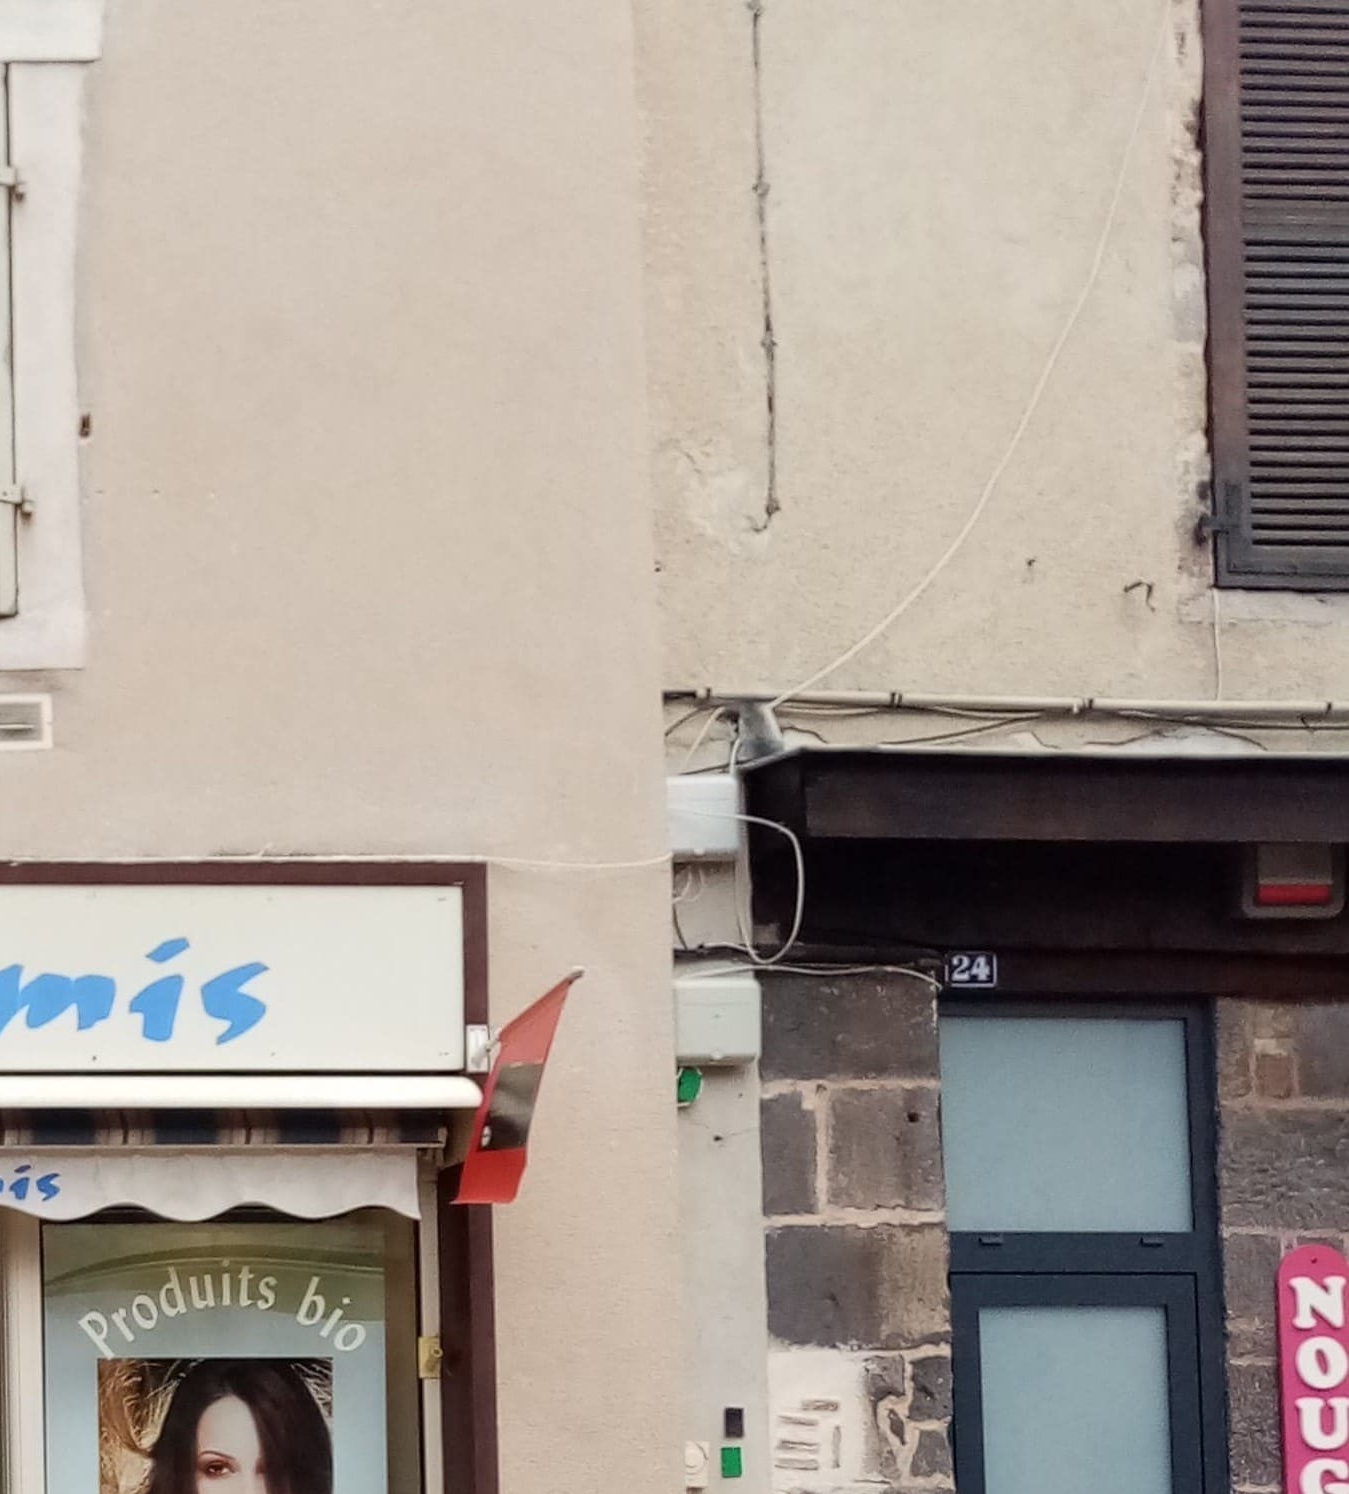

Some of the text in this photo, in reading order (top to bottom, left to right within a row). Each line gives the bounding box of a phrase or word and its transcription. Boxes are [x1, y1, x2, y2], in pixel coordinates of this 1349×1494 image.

[951, 954, 990, 982] 24
[78, 1258, 367, 1361] Produits bio
